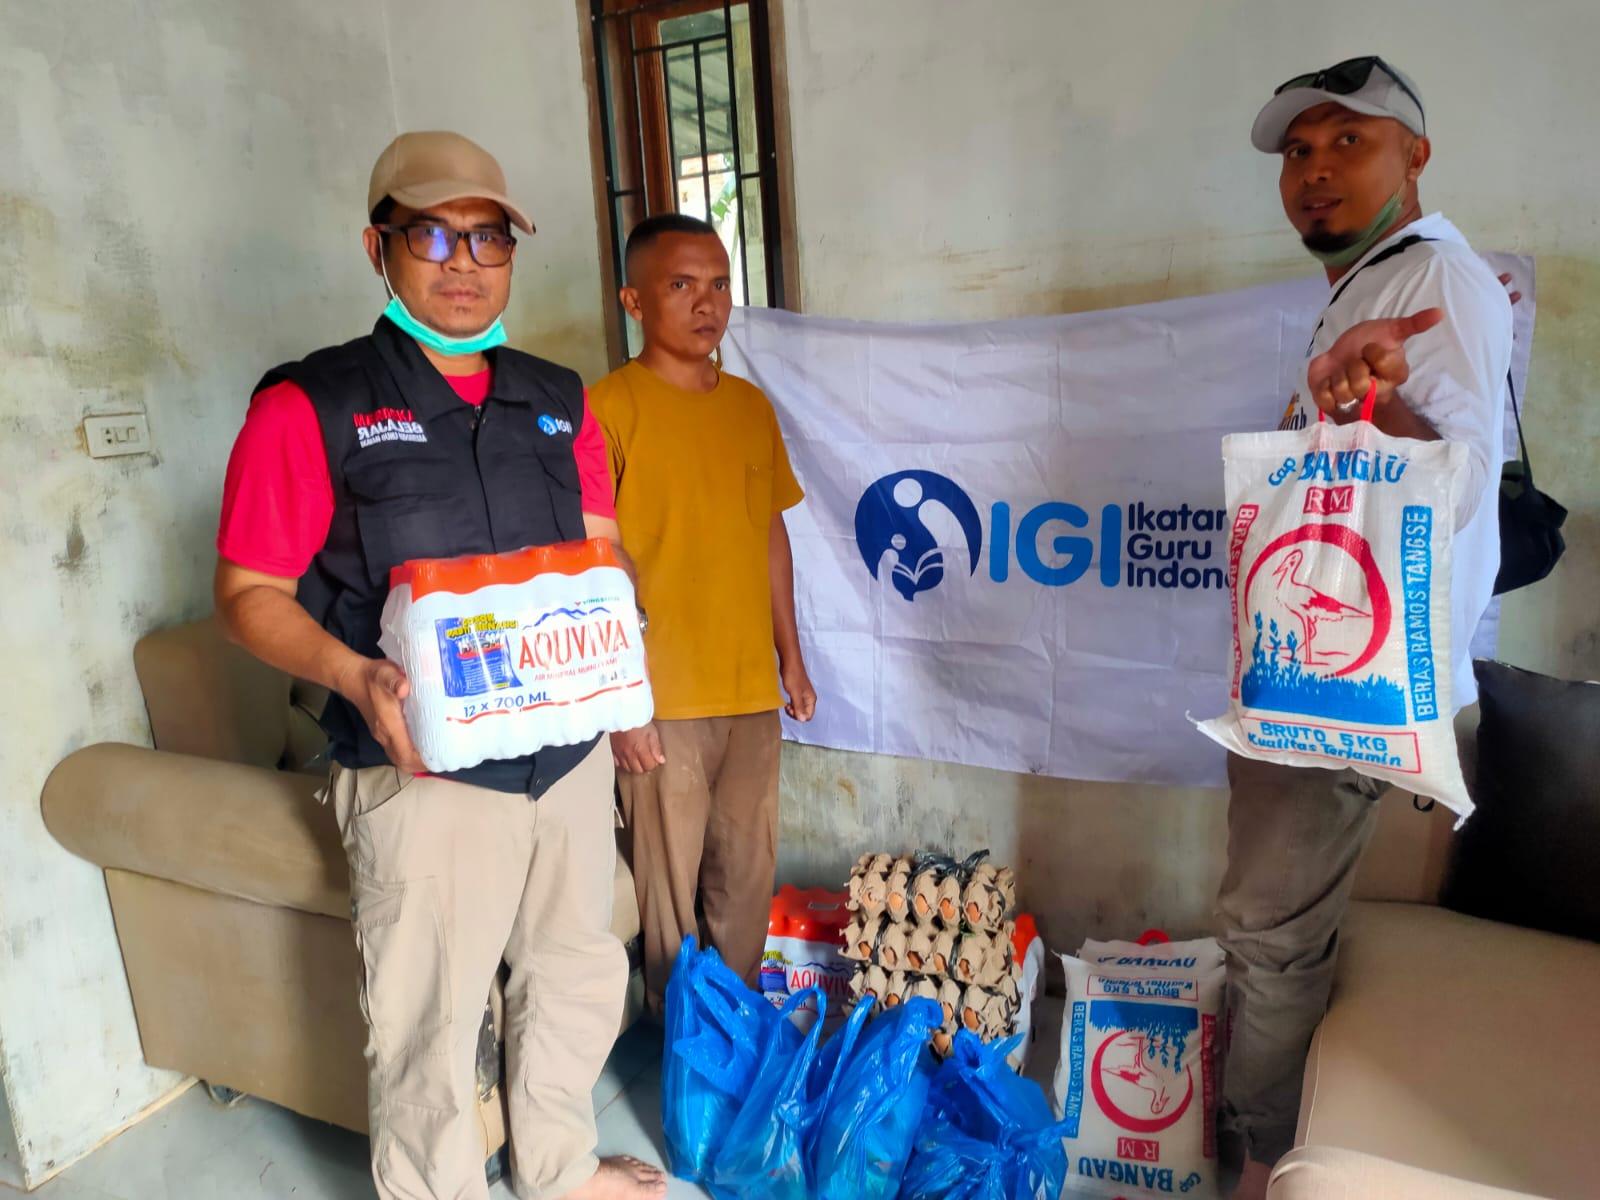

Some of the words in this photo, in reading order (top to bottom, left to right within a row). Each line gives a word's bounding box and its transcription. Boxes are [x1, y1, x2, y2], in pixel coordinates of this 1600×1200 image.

[989, 501, 1122, 588] IGI
[1127, 533, 1212, 560] Guru
[1230, 507, 1255, 561] BERAS
[1405, 511, 1428, 584] TANGSE
[1127, 561, 1231, 589] Indon
[1409, 591, 1426, 653] RAMOS
[519, 619, 630, 670] AQUVIVA
[463, 704, 476, 718] 12
[495, 695, 524, 709] 700
[529, 690, 551, 704] ML
[1412, 656, 1434, 716] BERAS
[1247, 732, 1317, 753] Kualitas
[1322, 743, 1403, 768] Terjamin
[1259, 721, 1327, 743] BRUTO
[1072, 1004, 1085, 1042] BERAS
[1071, 1045, 1083, 1087] RAMOS
[1078, 1156, 1174, 1193] BANGAU
